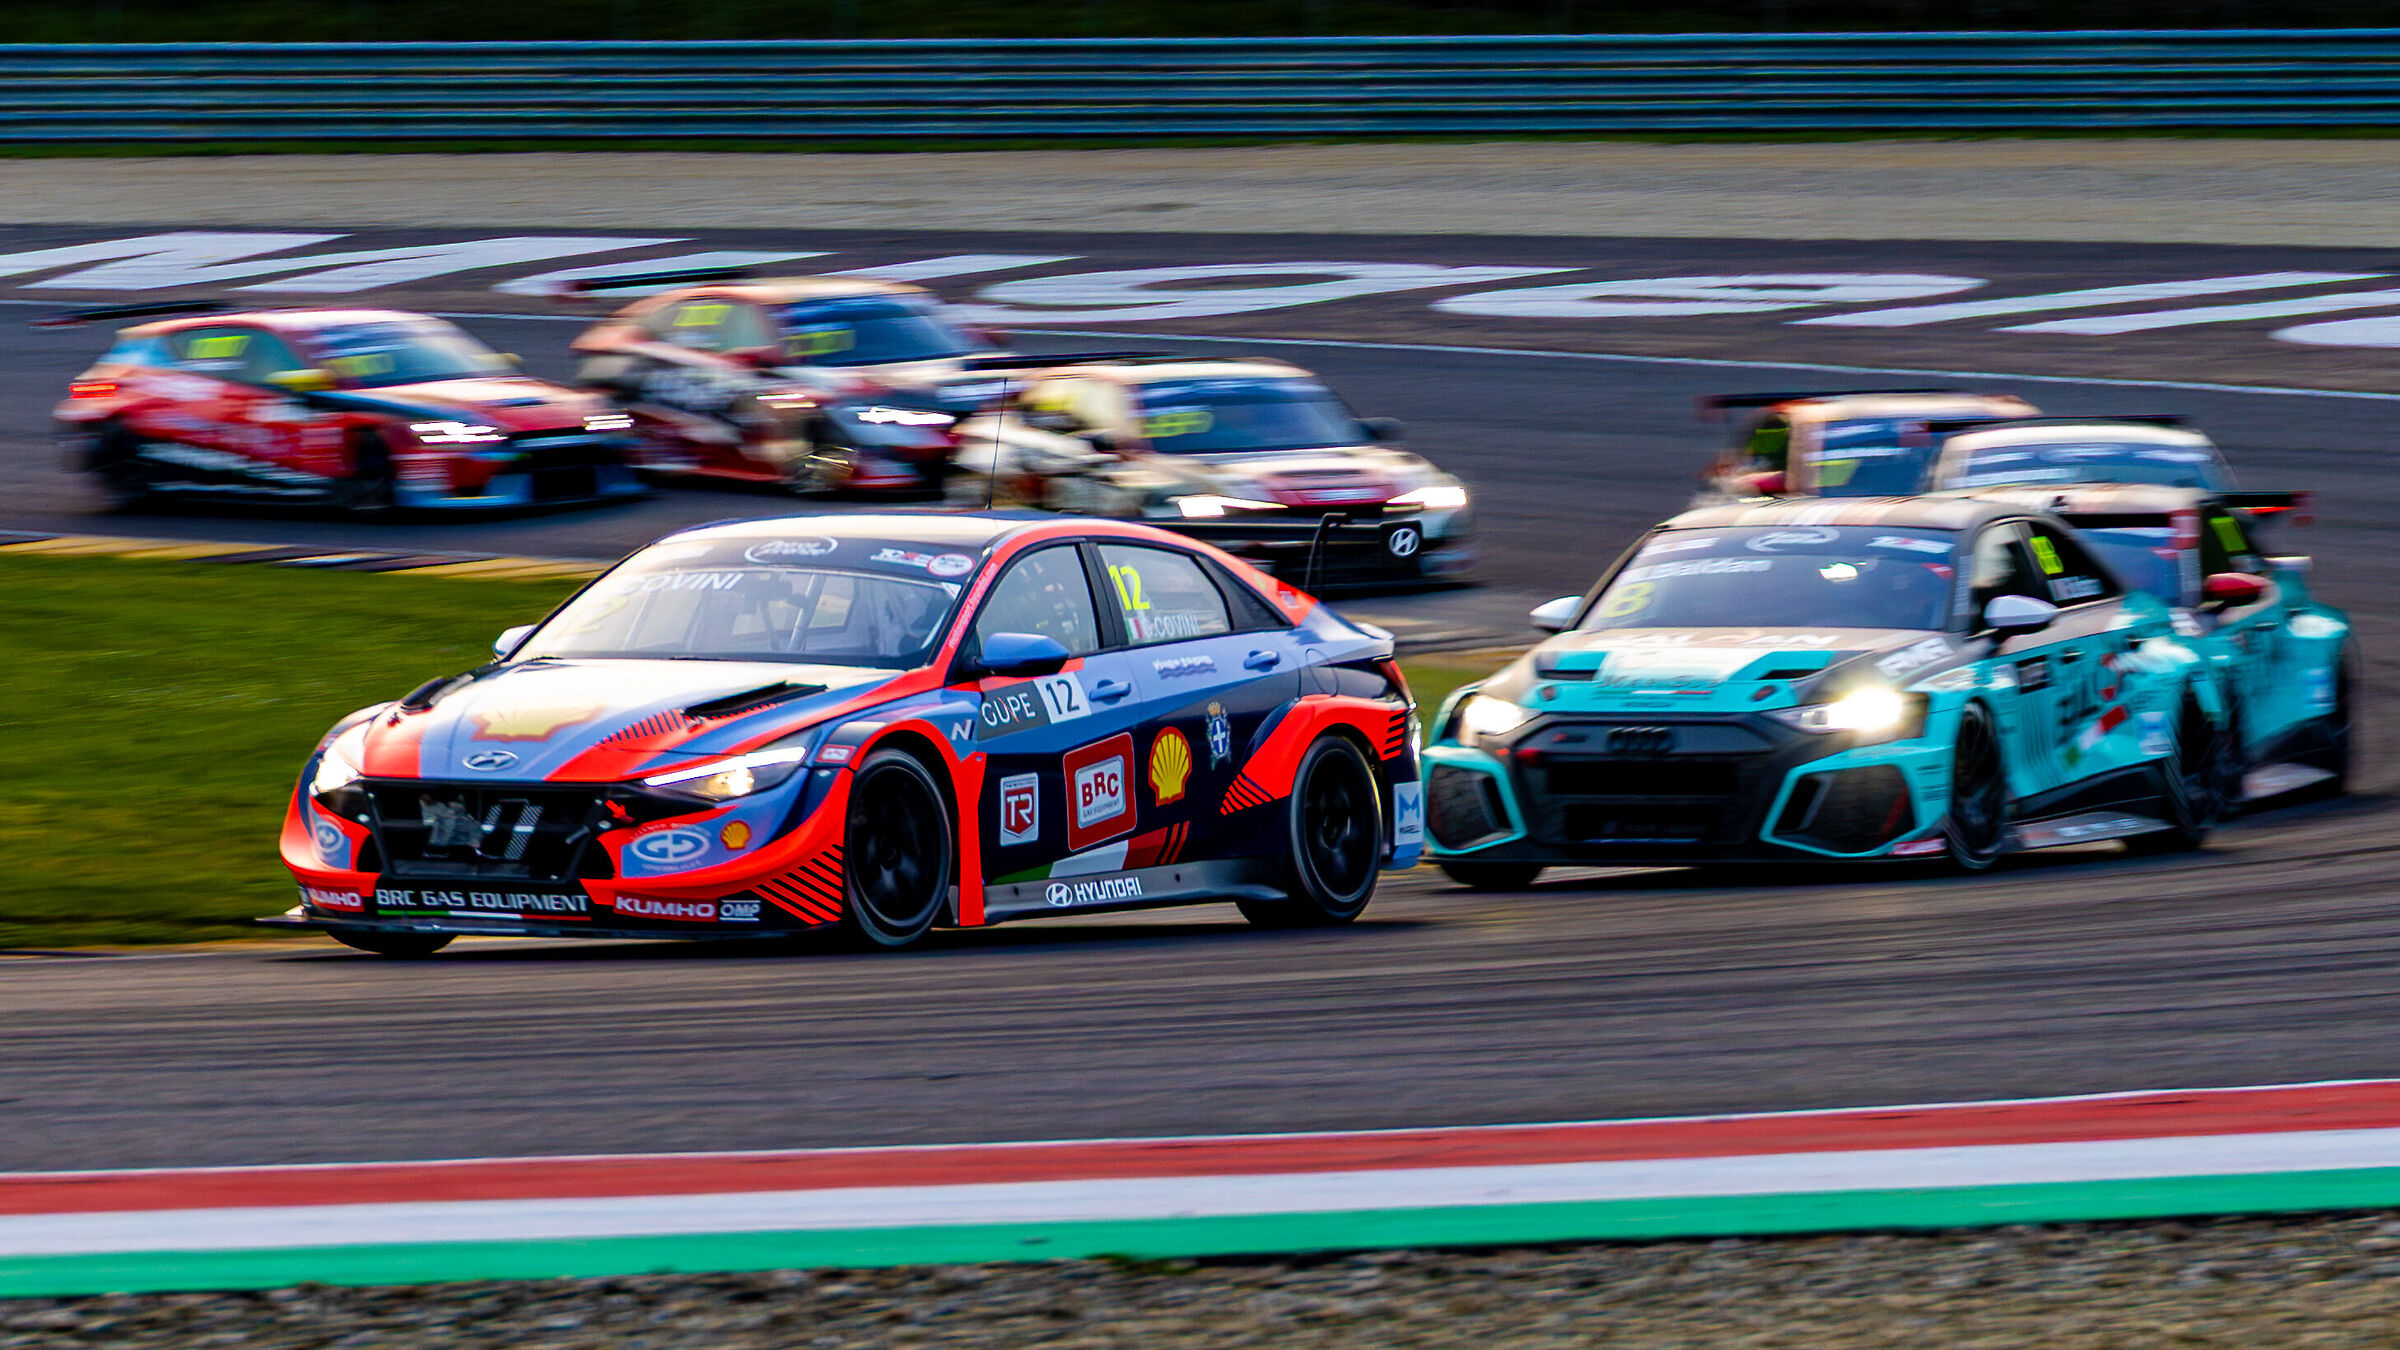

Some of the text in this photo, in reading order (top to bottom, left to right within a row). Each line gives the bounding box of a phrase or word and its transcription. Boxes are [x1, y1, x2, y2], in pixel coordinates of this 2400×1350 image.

[1108, 564, 1150, 610] 12
[1601, 581, 1655, 618] 8
[1045, 680, 1080, 715] 12
[1081, 771, 1120, 808] BRC
[1007, 793, 1033, 826] TR
[376, 888, 588, 911] BRC GAS EQUIPMENT
[1074, 876, 1142, 902] HYUNDAI
[615, 895, 716, 918] KUMHO
[720, 902, 760, 918] OMP
